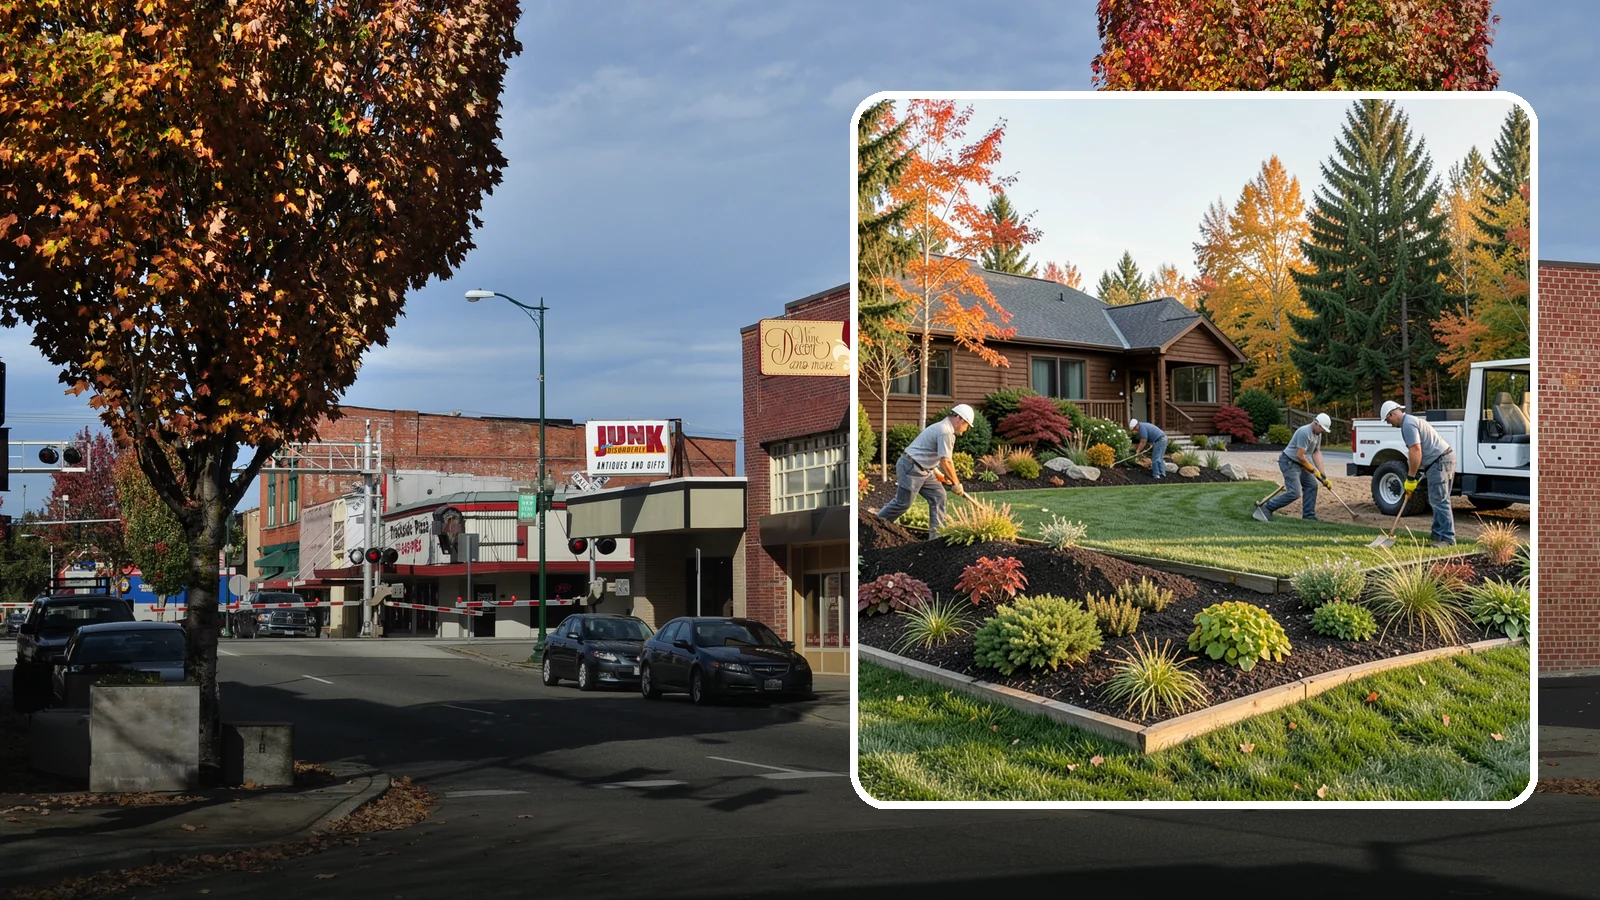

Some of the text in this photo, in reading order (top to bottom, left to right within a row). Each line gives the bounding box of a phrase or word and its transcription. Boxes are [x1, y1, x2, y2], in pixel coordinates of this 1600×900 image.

[595, 425, 665, 457] JUNK
[607, 446, 646, 454] DISORDERLY
[596, 460, 665, 470] ANTIQUES AND GIFTS
